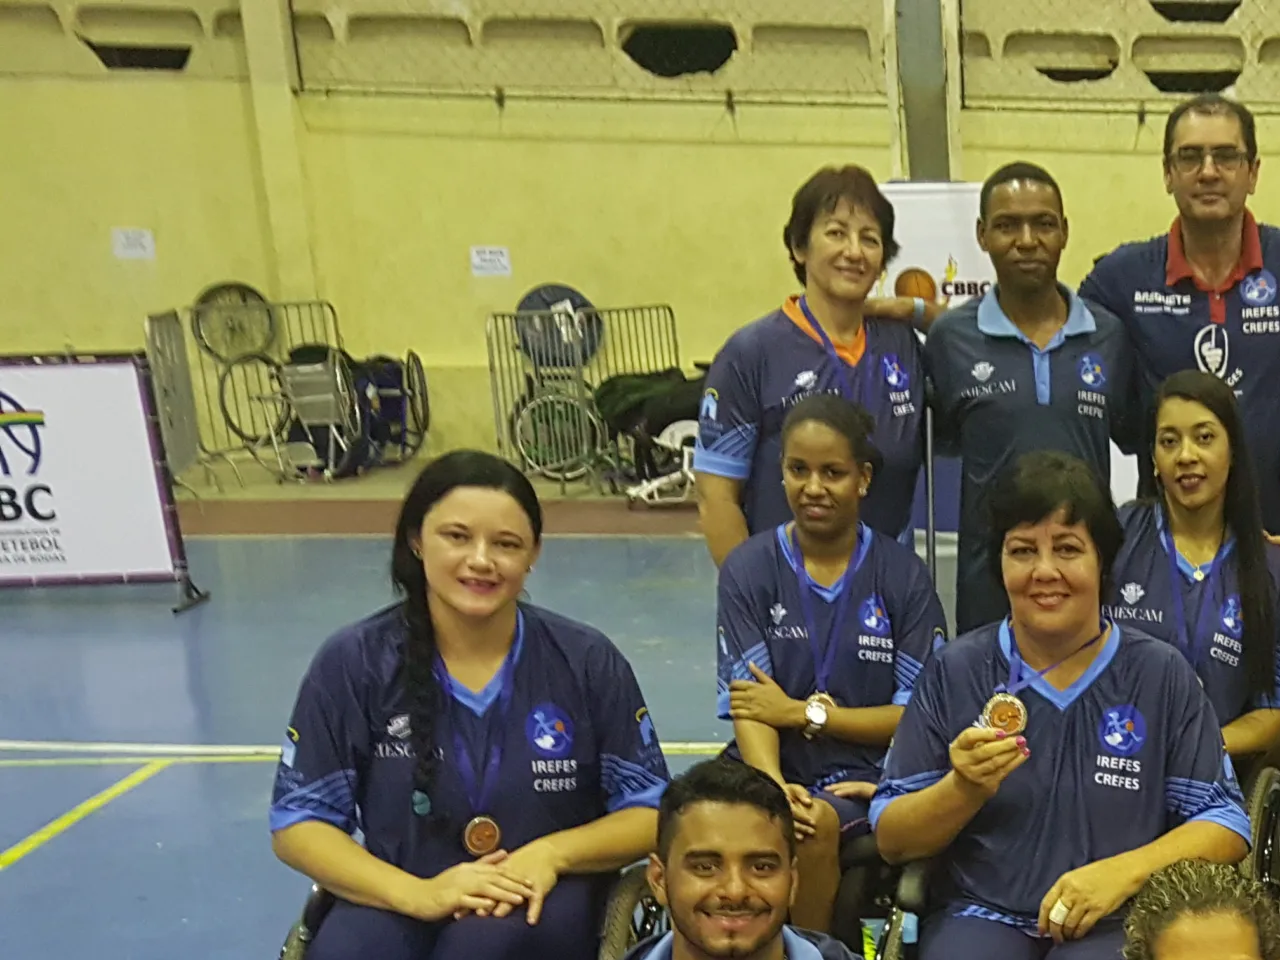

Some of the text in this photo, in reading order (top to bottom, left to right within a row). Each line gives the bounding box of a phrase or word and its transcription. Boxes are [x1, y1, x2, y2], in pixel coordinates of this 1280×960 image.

[1241, 305, 1280, 319] IREFES
[1242, 320, 1280, 334] CREFES
[858, 634, 893, 649] IREFES
[1213, 632, 1242, 653] IREFES
[857, 649, 893, 663] CREFES
[1210, 646, 1240, 667] CREFES
[531, 760, 577, 774] IREFES
[1096, 755, 1141, 773] IREFES
[534, 777, 577, 791] CREFES
[1094, 772, 1140, 790] CREFES
